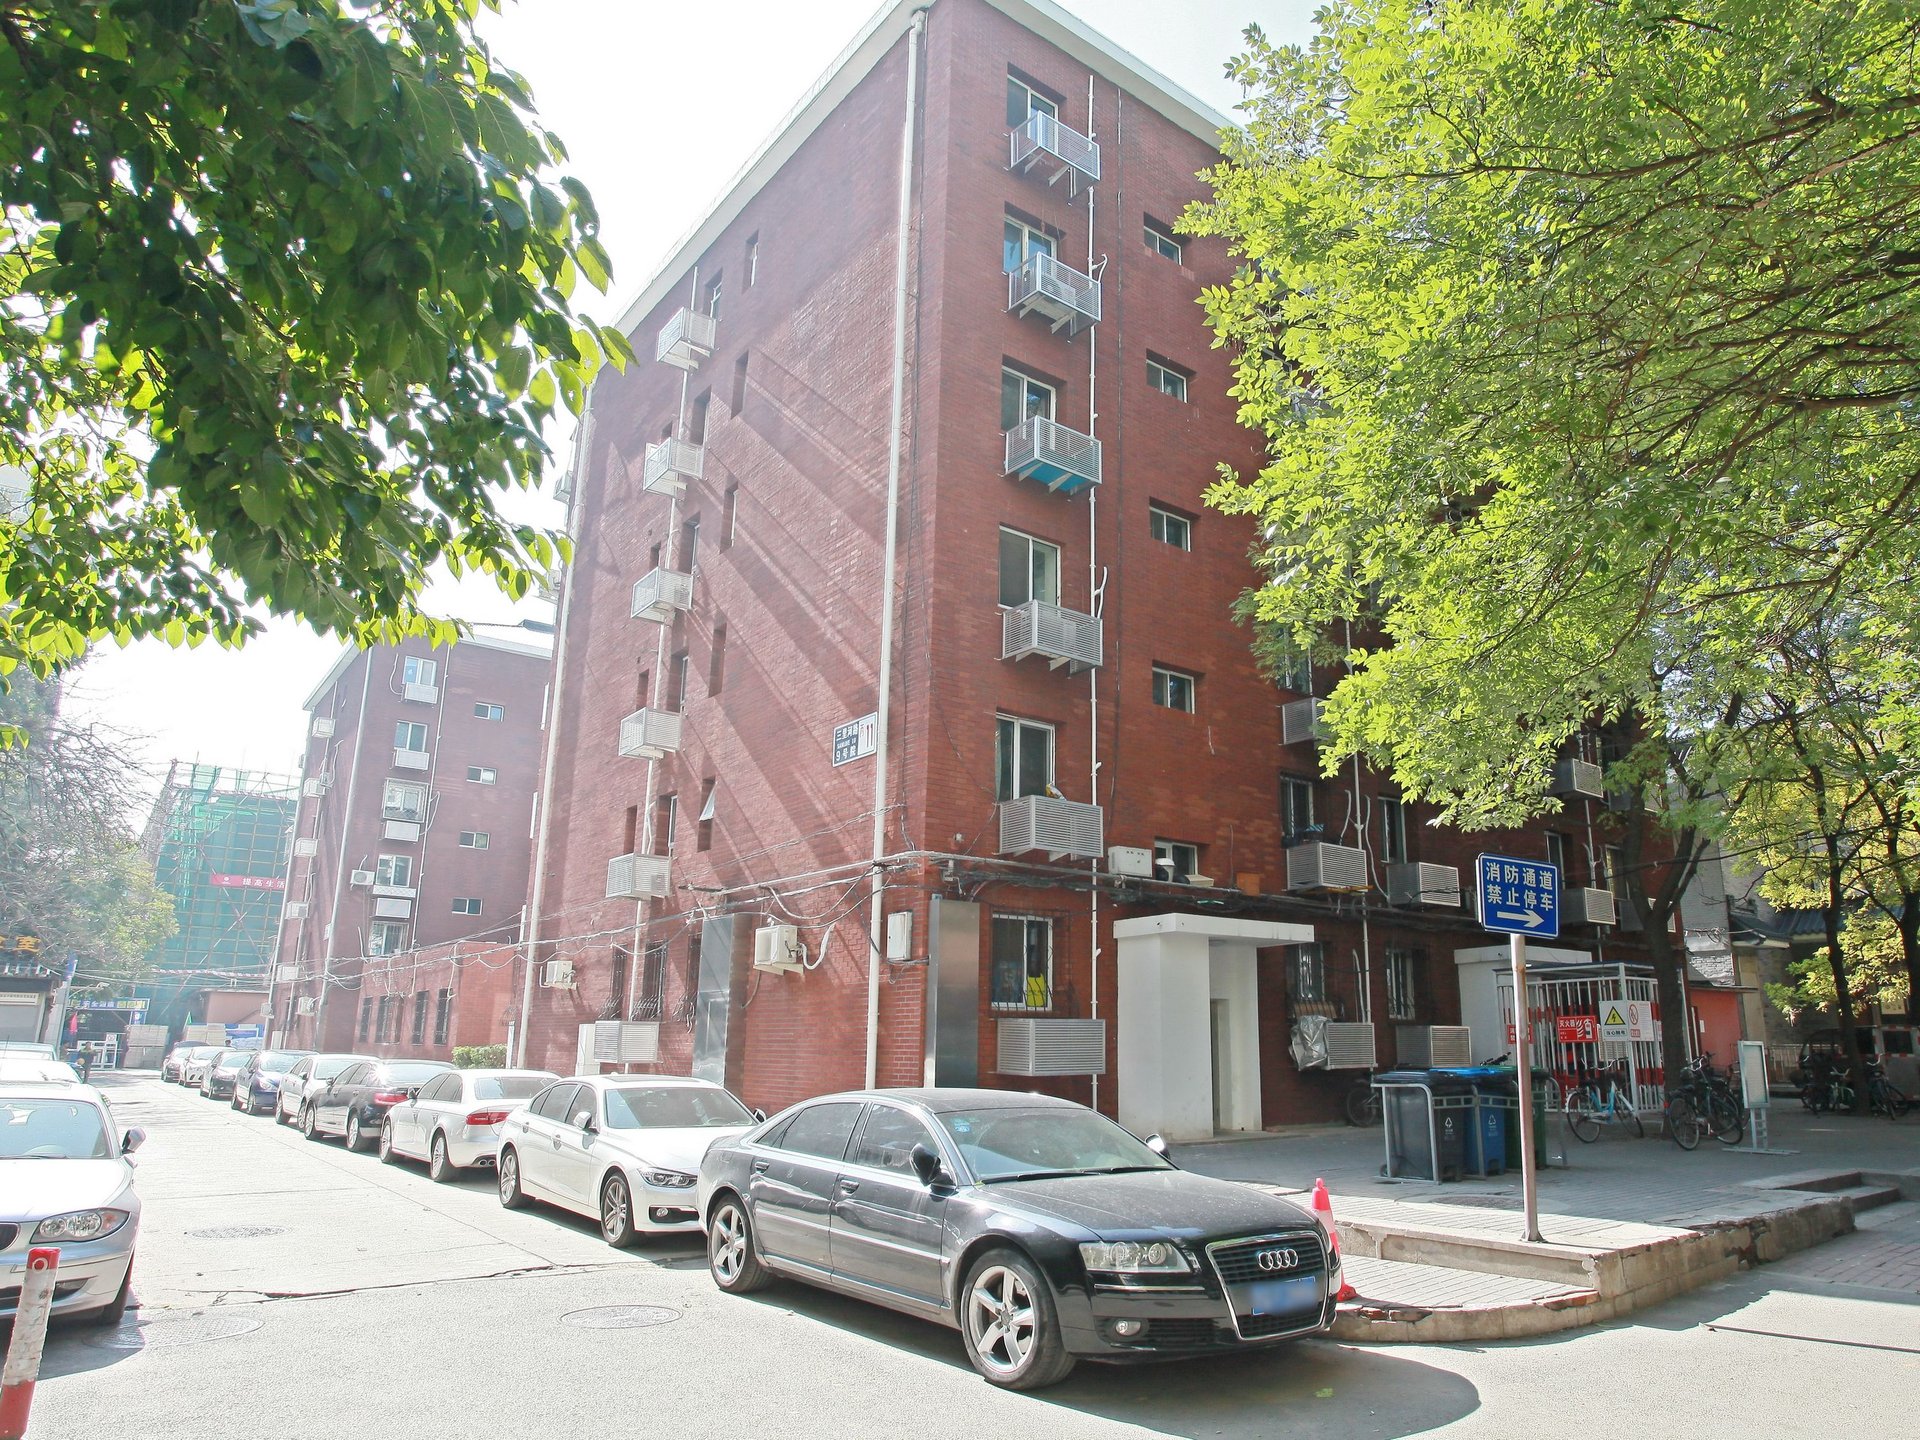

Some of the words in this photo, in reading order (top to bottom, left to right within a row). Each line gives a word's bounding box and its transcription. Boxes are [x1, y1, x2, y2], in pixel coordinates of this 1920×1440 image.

[836, 723, 858, 741] 三里河路
[835, 745, 857, 761] 9号院
[243, 878, 285, 888] 提高生活
[1486, 862, 1553, 890] 消防通道
[1487, 884, 1553, 911] 禁止停车
[0, 935, 40, 952] 室
[1559, 1019, 1576, 1028] 灭火器
